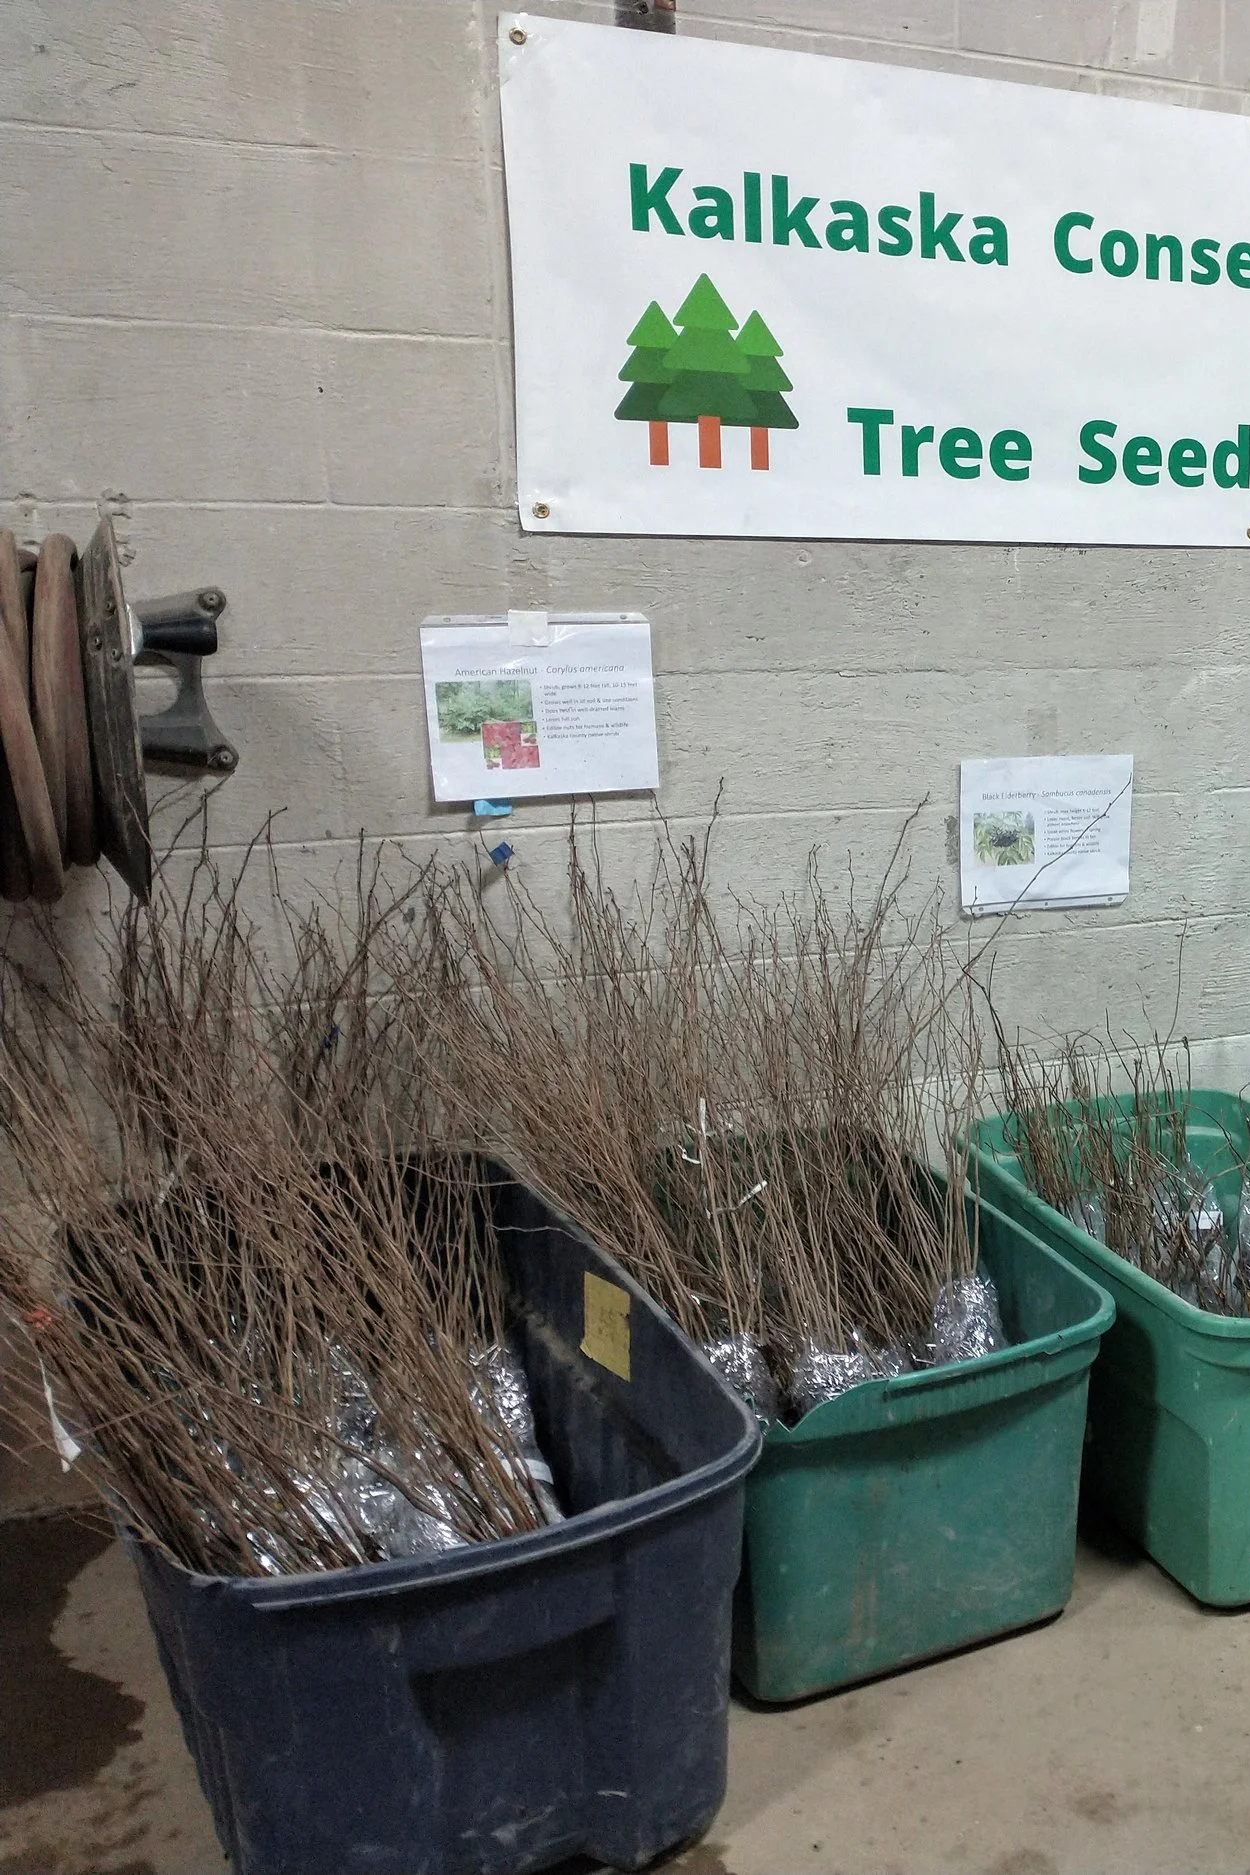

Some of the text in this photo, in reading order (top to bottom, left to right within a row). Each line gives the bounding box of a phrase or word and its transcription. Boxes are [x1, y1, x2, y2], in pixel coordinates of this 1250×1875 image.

[629, 162, 1010, 267] Kalkaska
[847, 407, 1033, 481] Tree
[454, 664, 625, 677] American Hazelnut Corylus americana
[982, 788, 1112, 801] Black Elderberry Sambucus canadensis
